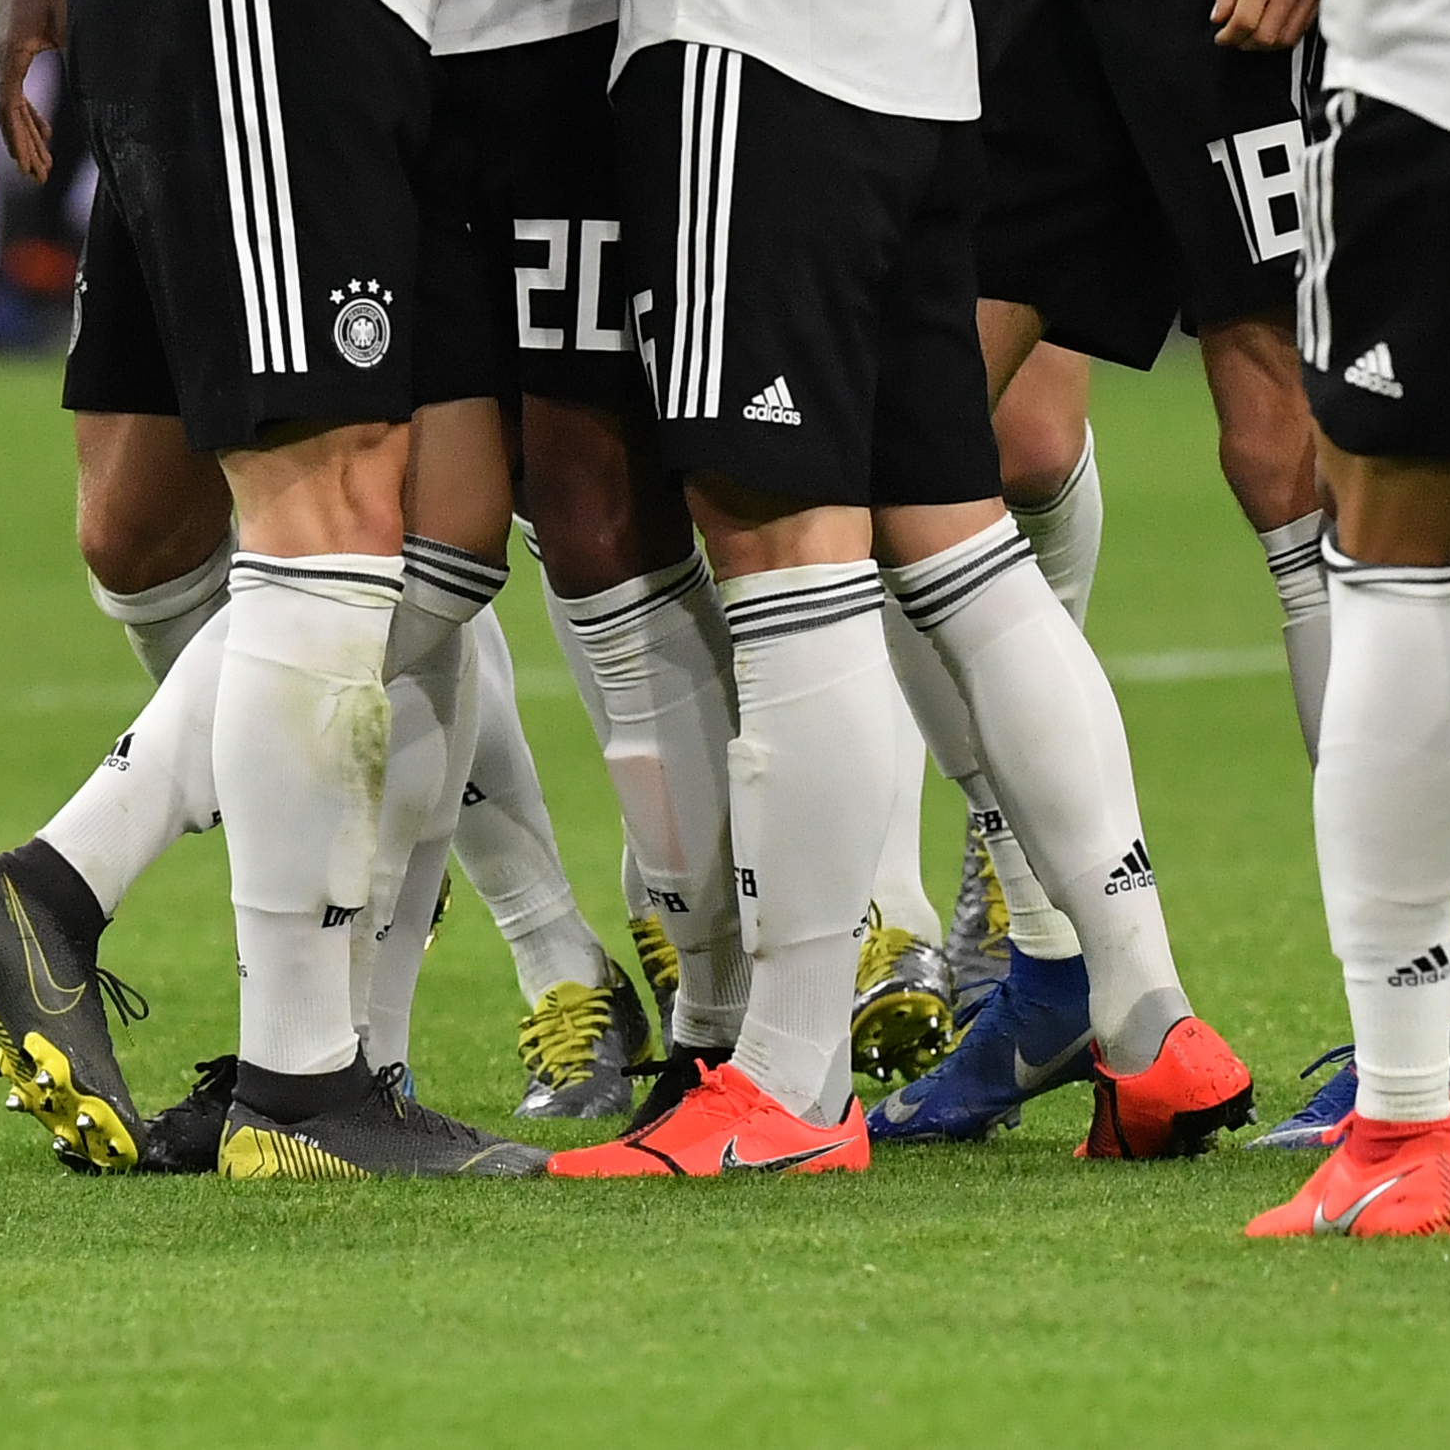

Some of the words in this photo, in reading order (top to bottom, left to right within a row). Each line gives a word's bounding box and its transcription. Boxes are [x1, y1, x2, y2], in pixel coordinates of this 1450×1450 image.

[1206, 118, 1308, 265] 18
[743, 404, 802, 426] adidas
[1104, 871, 1158, 896] adida
[646, 886, 690, 913] FB
